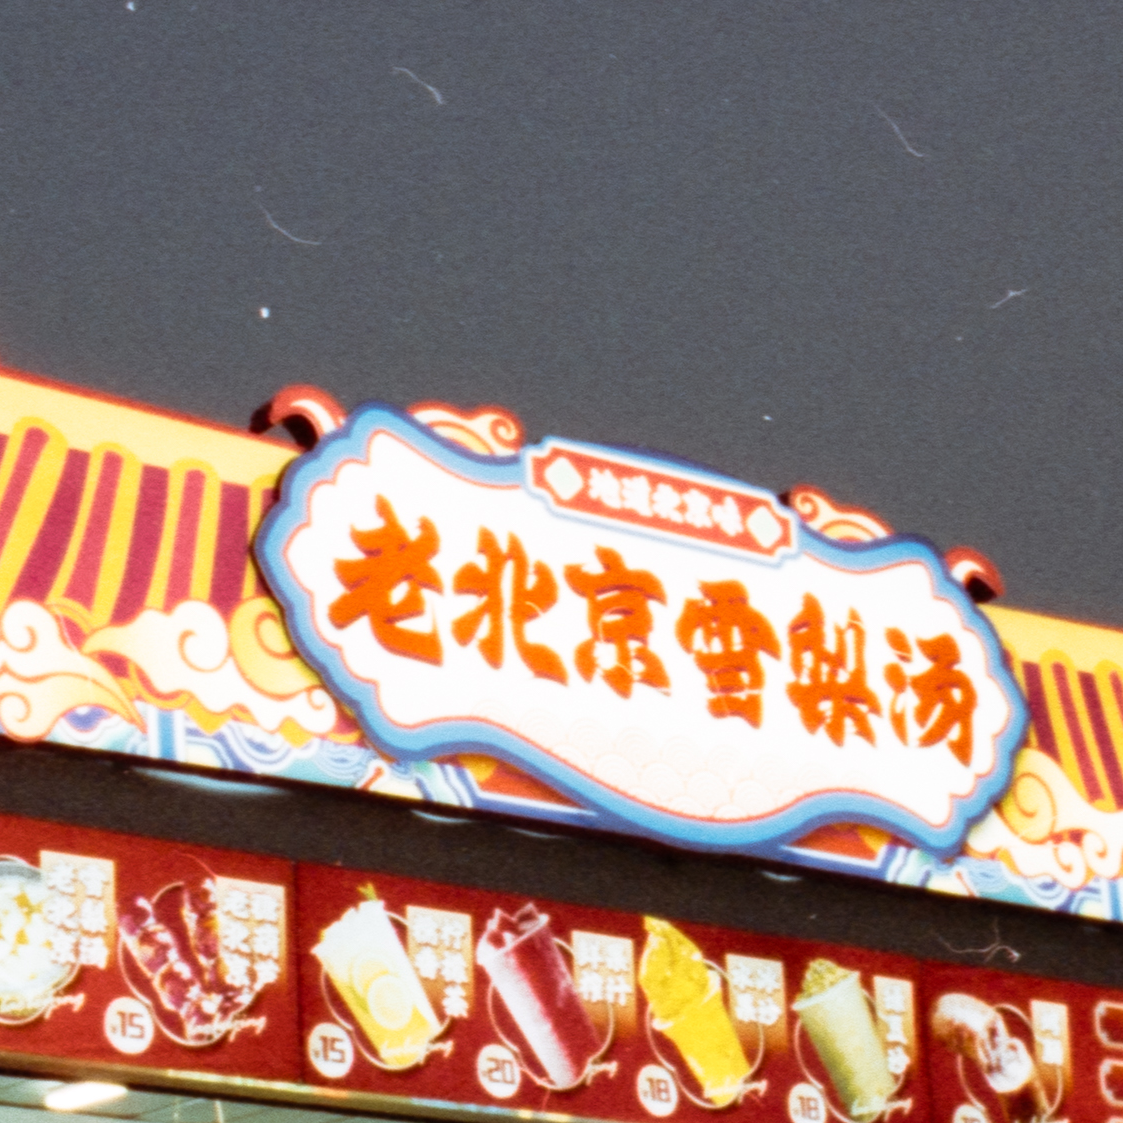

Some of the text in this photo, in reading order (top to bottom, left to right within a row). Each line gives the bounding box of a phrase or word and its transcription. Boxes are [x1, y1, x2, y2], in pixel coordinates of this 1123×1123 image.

[328, 494, 977, 767] 老北京雪梨汤
